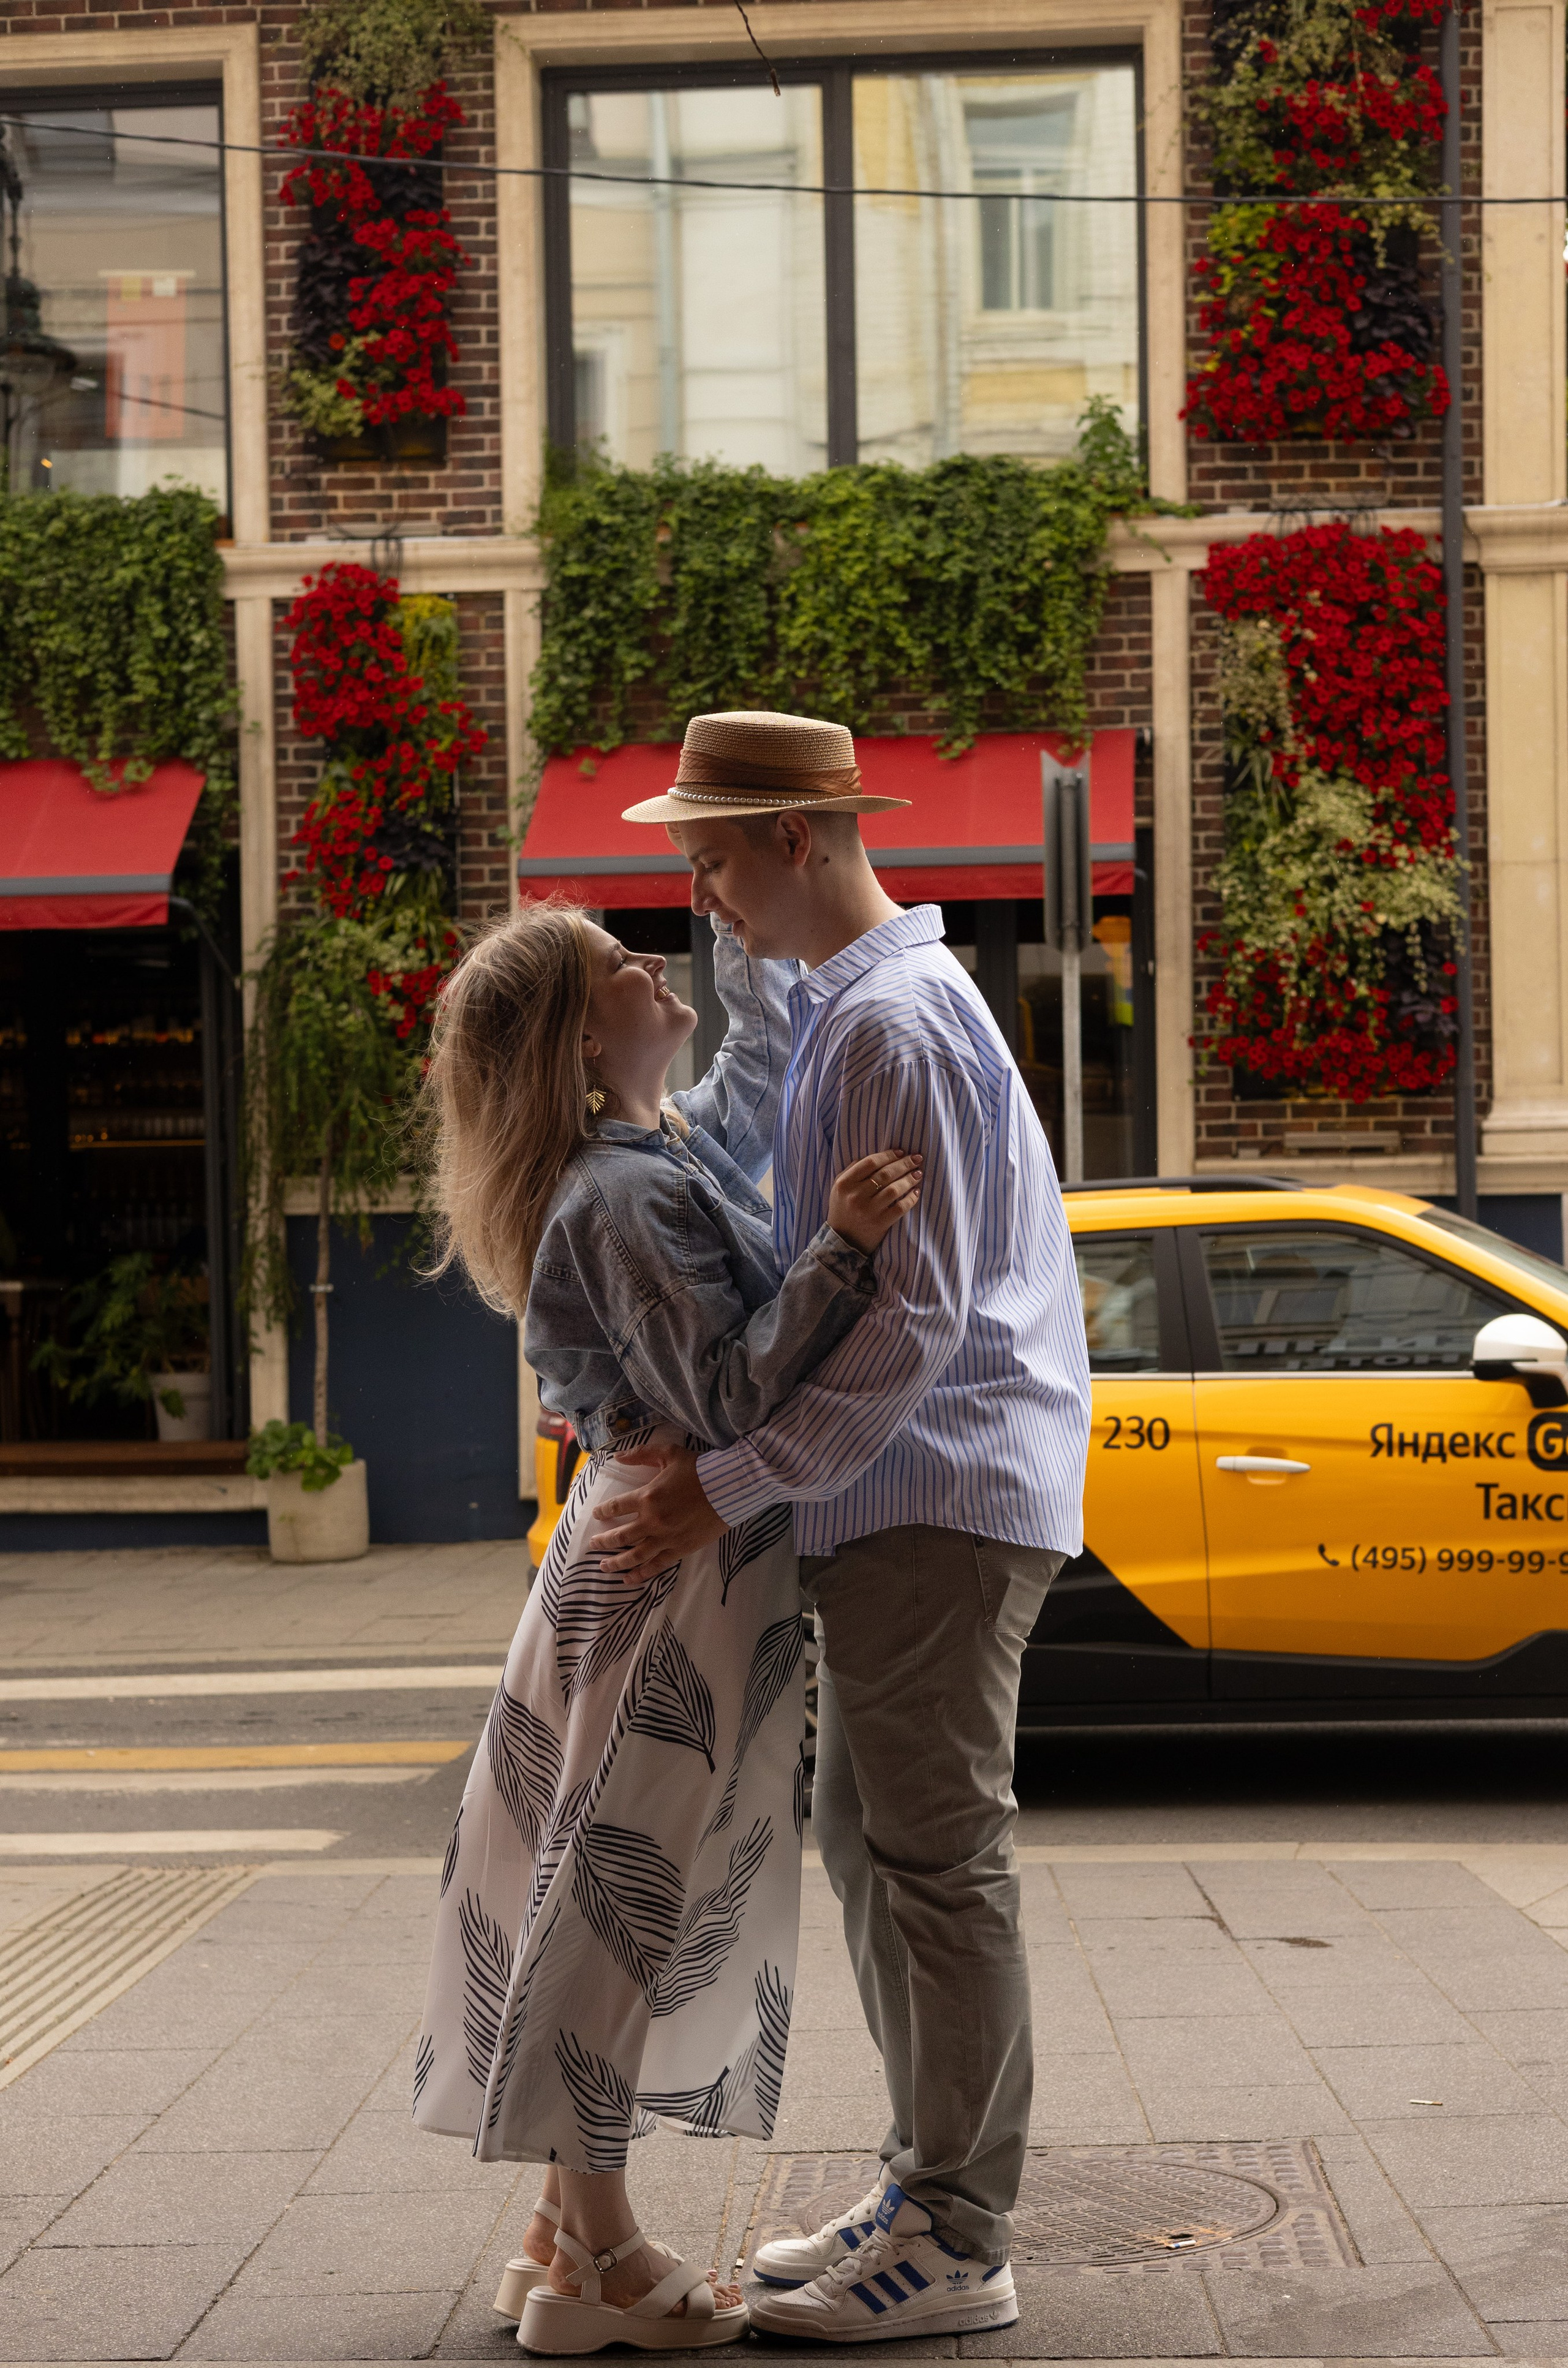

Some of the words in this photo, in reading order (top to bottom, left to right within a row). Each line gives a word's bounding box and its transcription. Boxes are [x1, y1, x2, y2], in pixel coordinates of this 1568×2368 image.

[1103, 1415, 1170, 1451] 230
[1370, 1423, 1516, 1463] Яндекс
[1535, 1421, 1568, 1461] G
[1475, 1482, 1568, 1521] Такс
[1352, 1544, 1427, 1575] (495)
[877, 2212, 889, 2225] adidas
[958, 2315, 990, 2326] adidas
